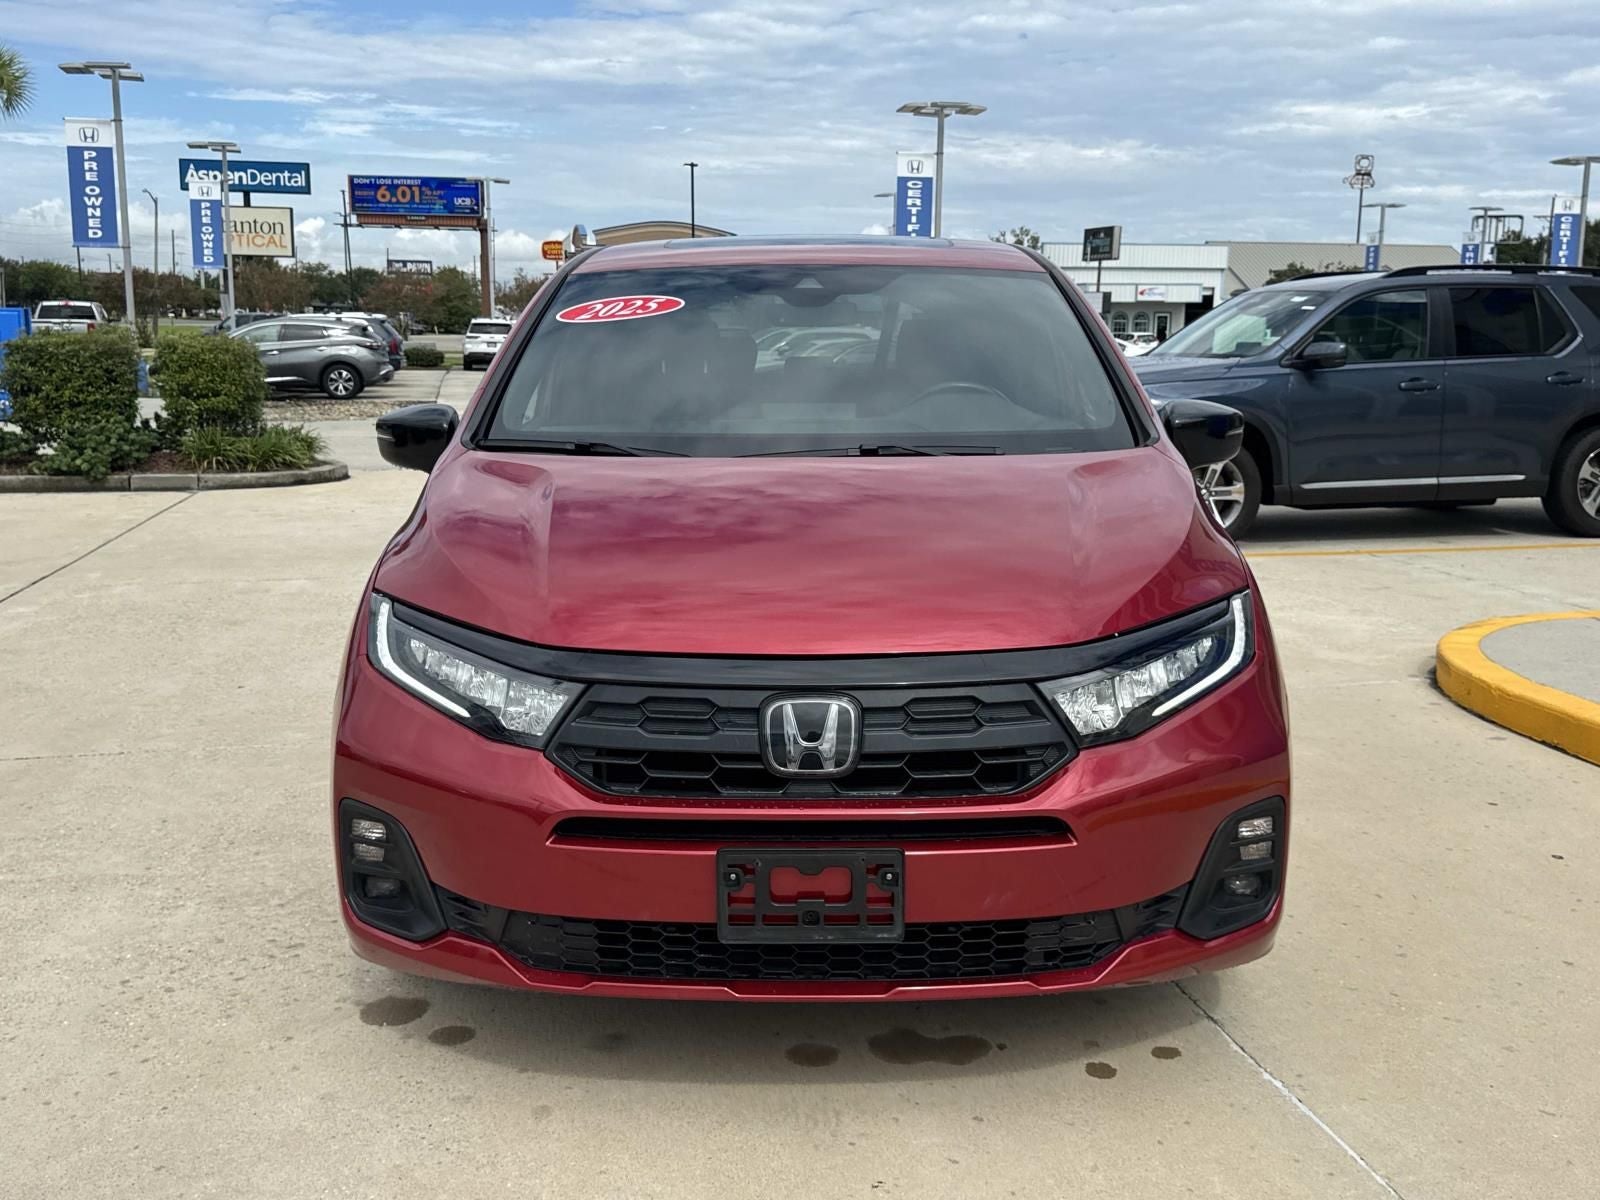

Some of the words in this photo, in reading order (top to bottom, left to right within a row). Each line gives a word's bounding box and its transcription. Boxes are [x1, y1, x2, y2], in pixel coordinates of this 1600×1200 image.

[83, 150, 98, 181] PRE
[393, 178, 422, 186] INTEREST
[376, 186, 420, 204] 6.01
[83, 185, 103, 239] OWNED
[201, 202, 212, 224] PRE
[229, 218, 285, 235] anton
[201, 226, 215, 263] OWNED
[575, 298, 667, 320] 2025
